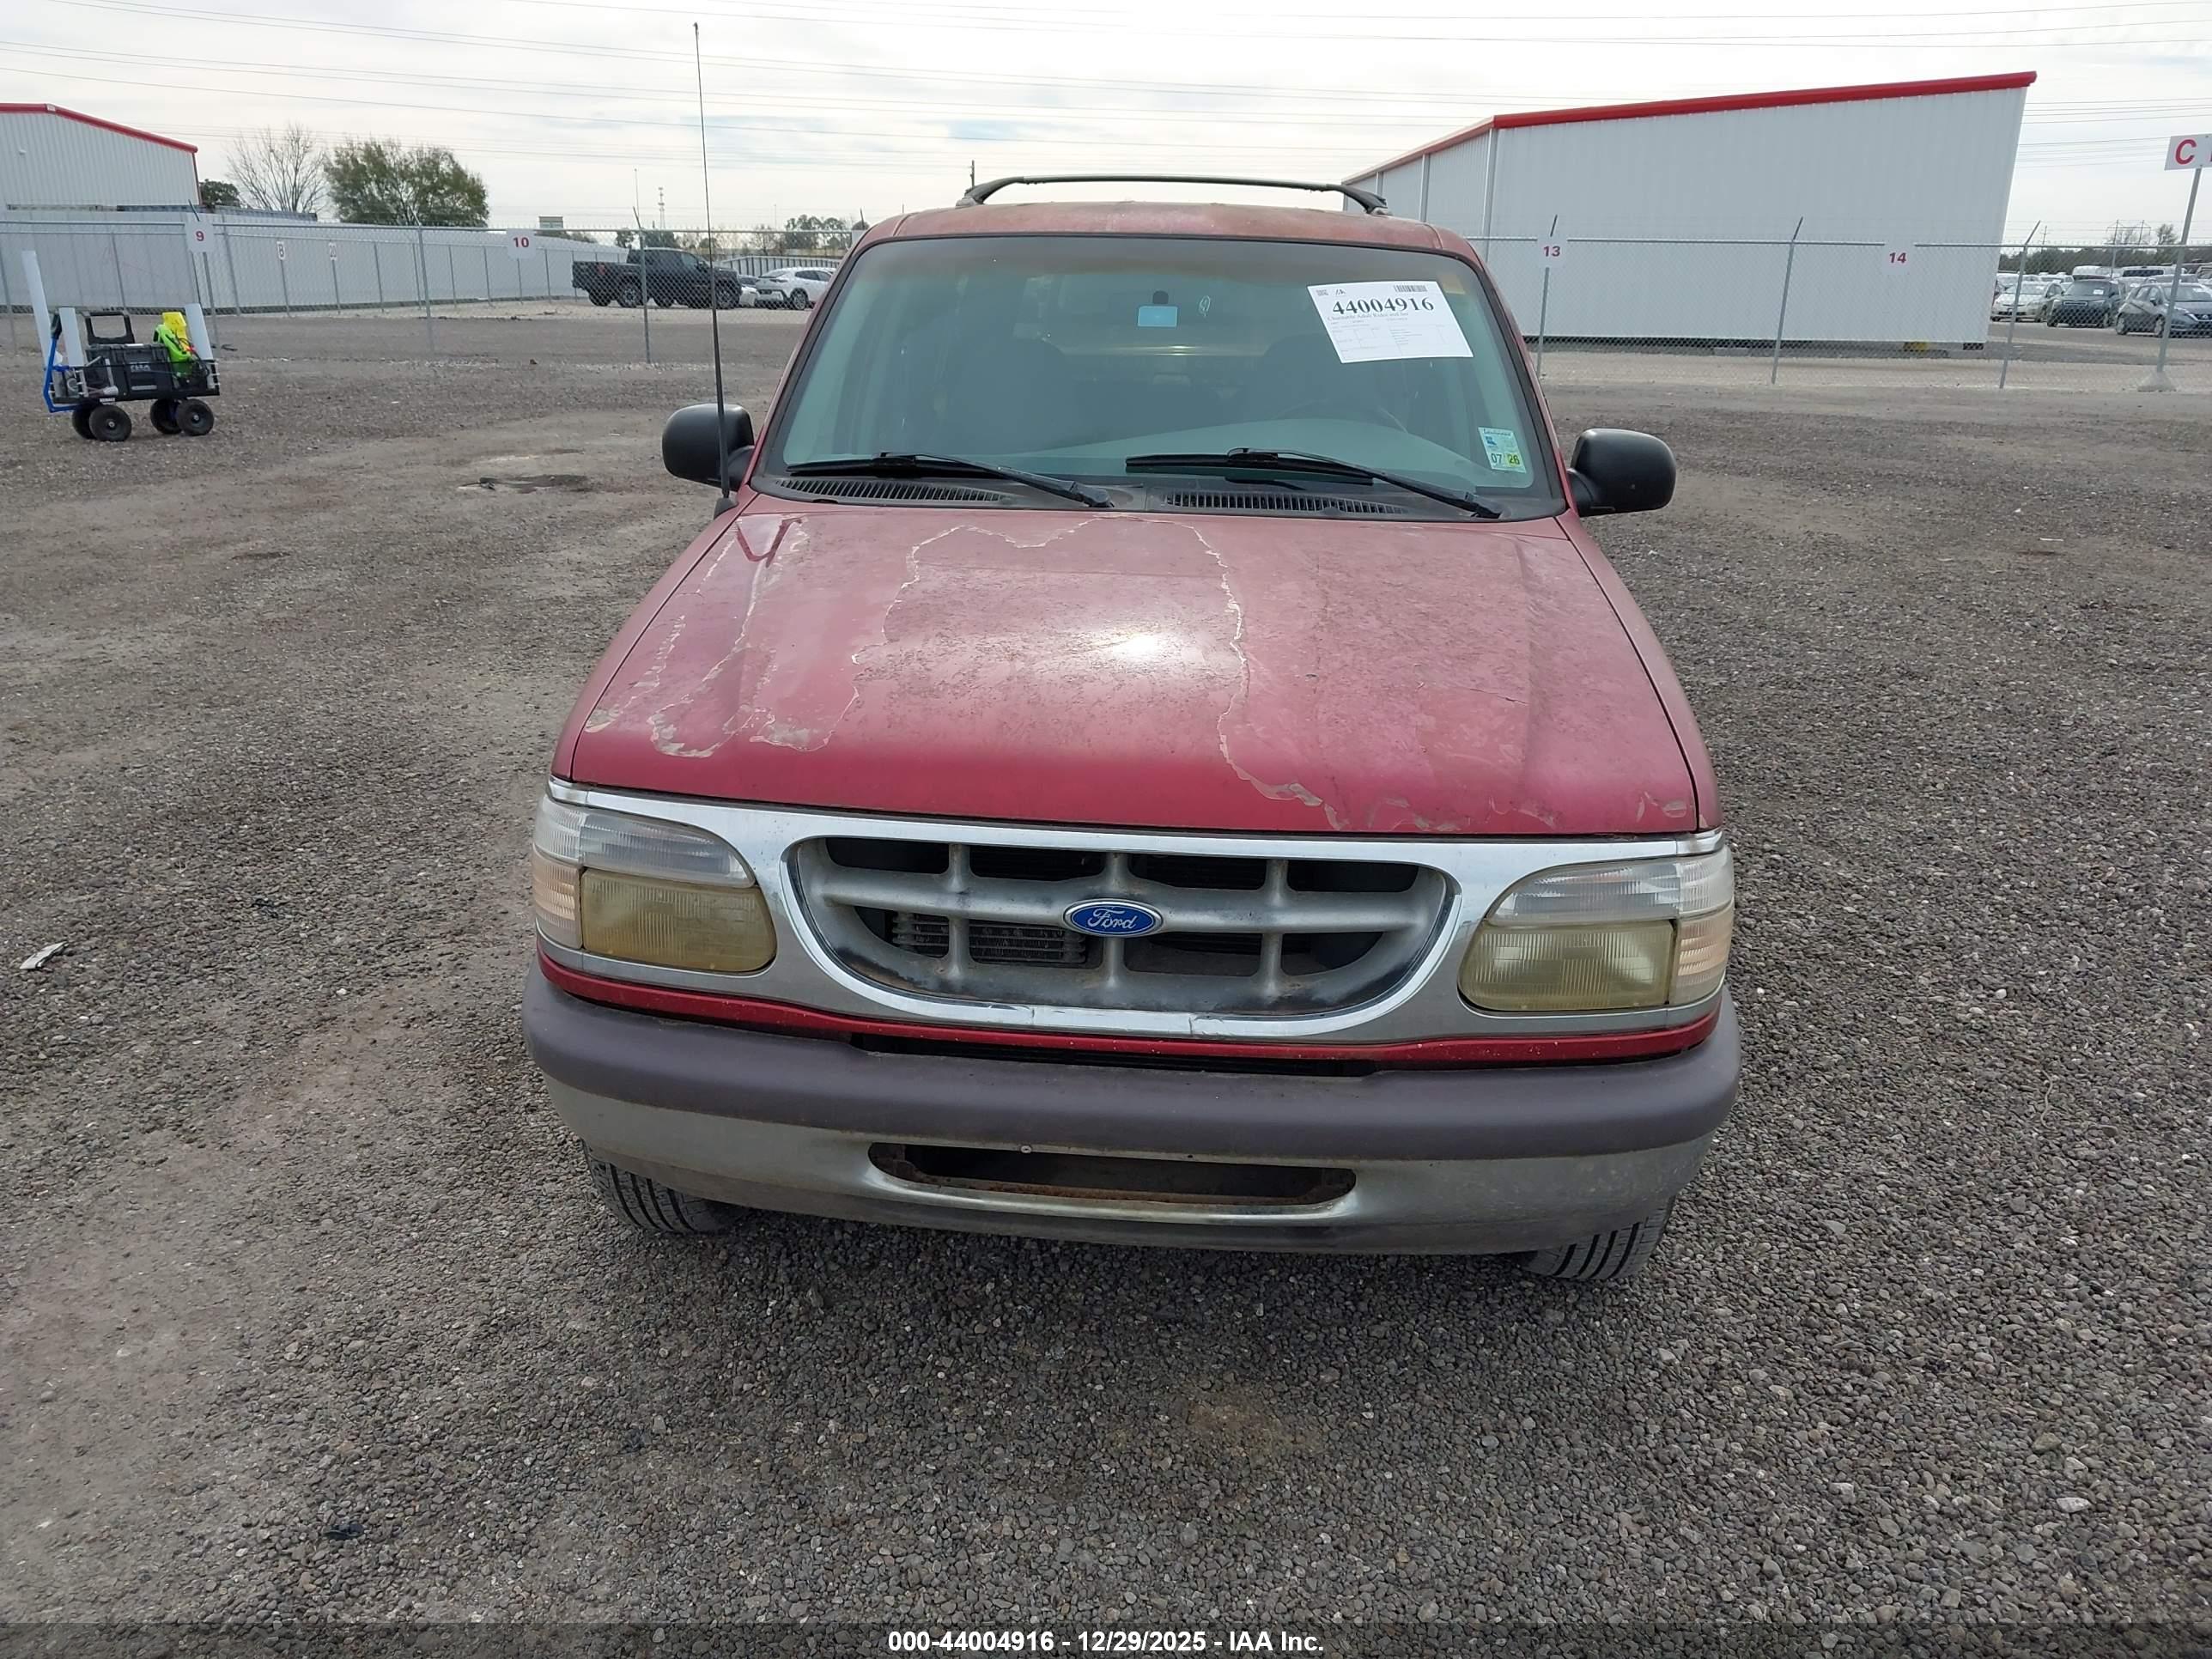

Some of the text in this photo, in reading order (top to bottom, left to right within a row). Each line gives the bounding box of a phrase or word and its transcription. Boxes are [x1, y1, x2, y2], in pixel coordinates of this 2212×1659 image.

[2175, 138, 2197, 165] C
[195, 230, 204, 242] 9
[513, 236, 530, 248] 10
[1543, 246, 1561, 258] 13
[1889, 252, 1907, 264] 14
[1332, 296, 1435, 314] 44004916
[1491, 453, 1502, 465] 07
[1087, 908, 1138, 929] Ford
